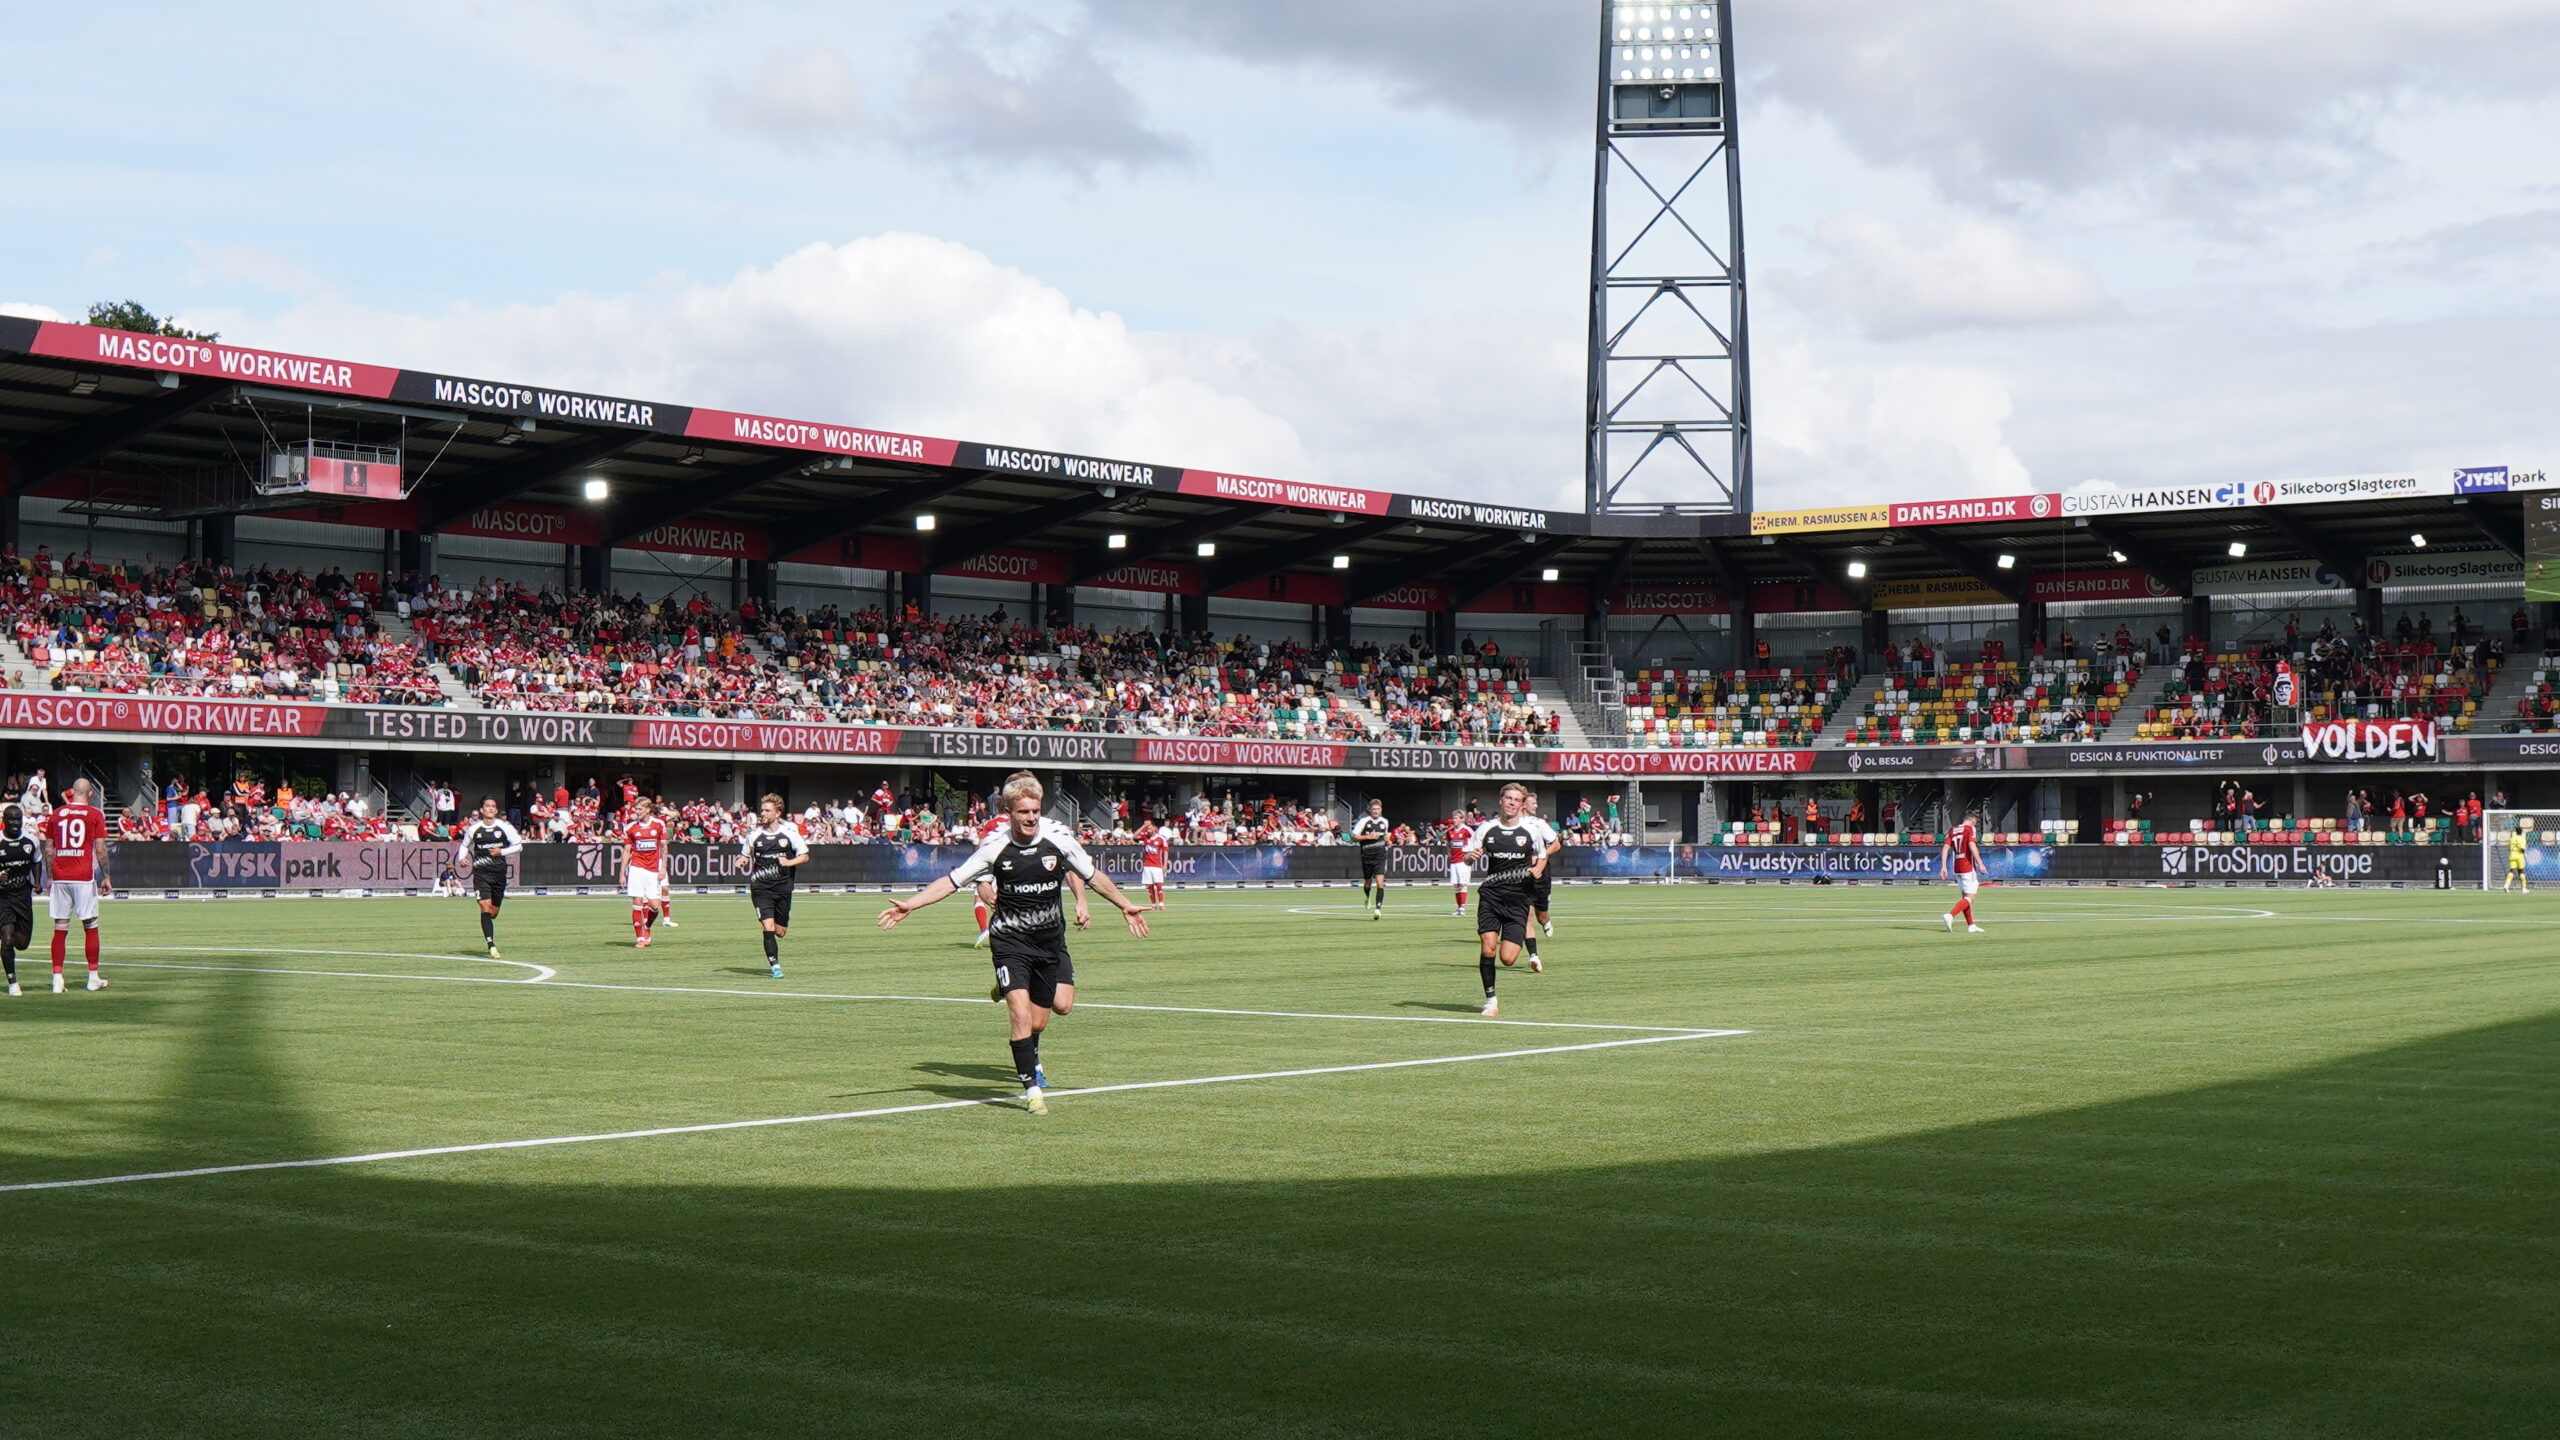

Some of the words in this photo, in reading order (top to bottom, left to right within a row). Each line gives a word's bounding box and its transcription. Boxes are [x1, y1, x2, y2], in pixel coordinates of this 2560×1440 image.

[218, 350, 352, 388] WORKWEAR
[538, 392, 653, 427] WORKWEAR
[823, 428, 923, 458] WORKWEAR
[1063, 457, 1153, 485] WORKWEAR
[2463, 471, 2506, 488] JYSK
[2512, 470, 2546, 486] park
[1286, 484, 1366, 509] WORKWEAR
[2541, 497, 2560, 510] SI
[1474, 506, 1546, 529] WORKWEAR
[1767, 516, 1801, 529] HERM.
[1803, 512, 1868, 525] RASMUSSEN
[1870, 511, 1887, 522] A/S
[1897, 500, 2017, 522] DANSAND.DK
[1098, 567, 1179, 588] OOTWEAR
[2036, 578, 2131, 594] DANSAND.DK
[1888, 583, 1924, 595] HERM.
[138, 702, 301, 733] WORKWEAR
[364, 711, 466, 738] TESTED
[477, 716, 509, 740] TO
[519, 717, 593, 743] WORK
[759, 726, 882, 752] WORKWEAR
[930, 733, 1008, 756] TESTED
[1015, 736, 1040, 757] TO
[1048, 738, 1106, 759] WORK
[2303, 720, 2436, 760] VOLDEN
[2519, 743, 2560, 755] DESIG
[1235, 744, 1332, 765] WORKWEAR
[1370, 748, 1432, 768] TESTED
[1438, 751, 1458, 768] TO
[1465, 751, 1516, 770] WORK
[1668, 753, 1796, 772] WORKWEAR
[1879, 756, 1914, 766] BESLAG
[2070, 751, 2112, 762] DESIGN
[2115, 751, 2123, 762] &
[2126, 749, 2223, 761] FUNKTIONALITET
[58, 818, 86, 848] 19
[208, 852, 277, 878] JYSK
[286, 852, 342, 883] park
[1107, 853, 1127, 872] alt
[1130, 853, 1143, 872] fo
[1719, 853, 1804, 874] AV-udstyr
[1809, 853, 1824, 870] til
[1829, 854, 1850, 870] alt
[1854, 853, 1876, 870] for
[1881, 854, 1931, 875] Sport
[2195, 847, 2287, 879] ProShop
